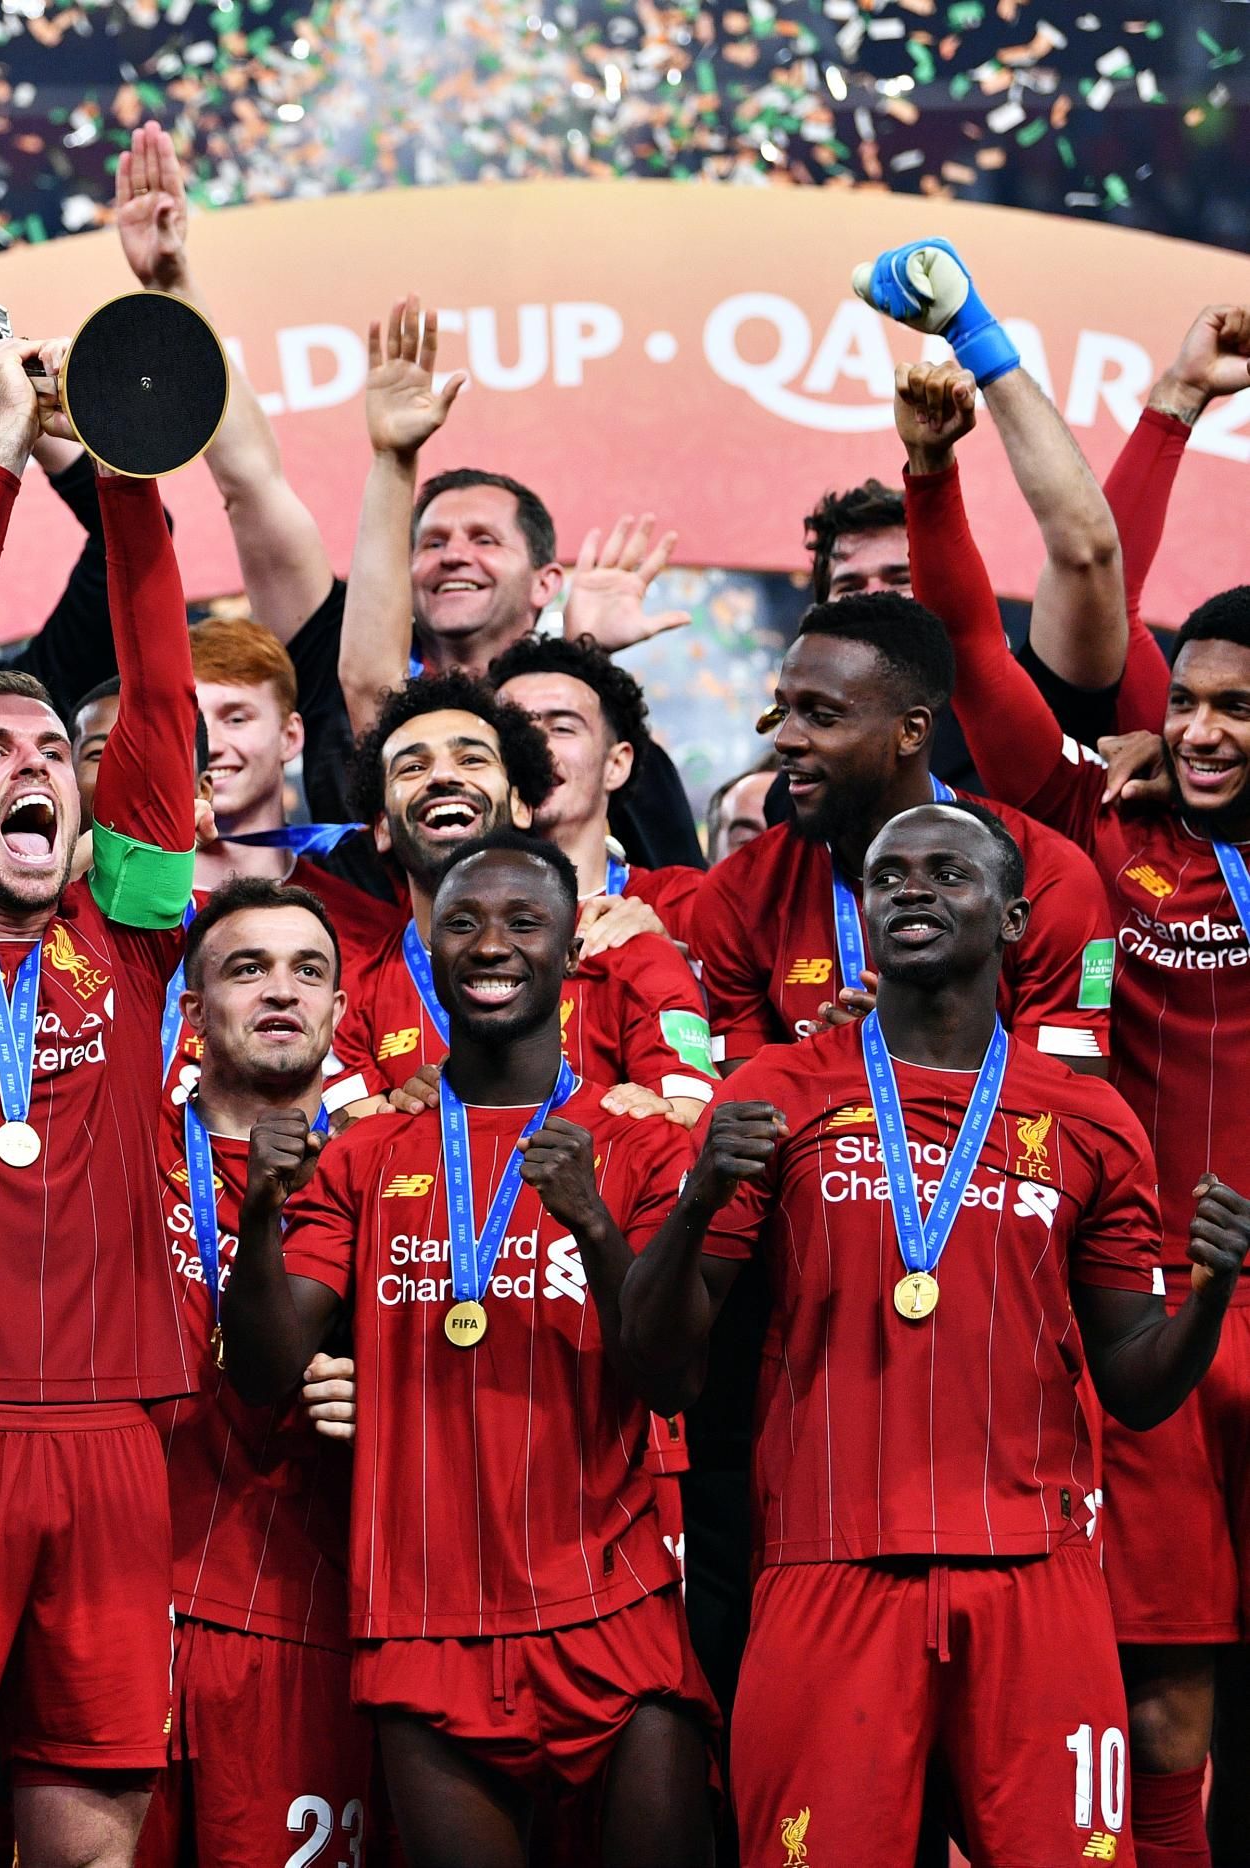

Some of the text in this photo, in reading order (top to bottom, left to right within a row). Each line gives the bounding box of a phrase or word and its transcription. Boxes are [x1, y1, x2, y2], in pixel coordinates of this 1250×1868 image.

[703, 292, 1151, 446] QAR
[1119, 928, 1250, 969] Chartere
[962, 1139, 973, 1159] FIFA
[821, 1171, 1006, 1211] Chateed
[950, 1169, 962, 1189] FIFA
[938, 1199, 950, 1220] FIFA
[927, 1230, 938, 1250] FIFA
[378, 1269, 535, 1305] Charred
[452, 1319, 478, 1329] FIFA
[1066, 1723, 1125, 1832] 10
